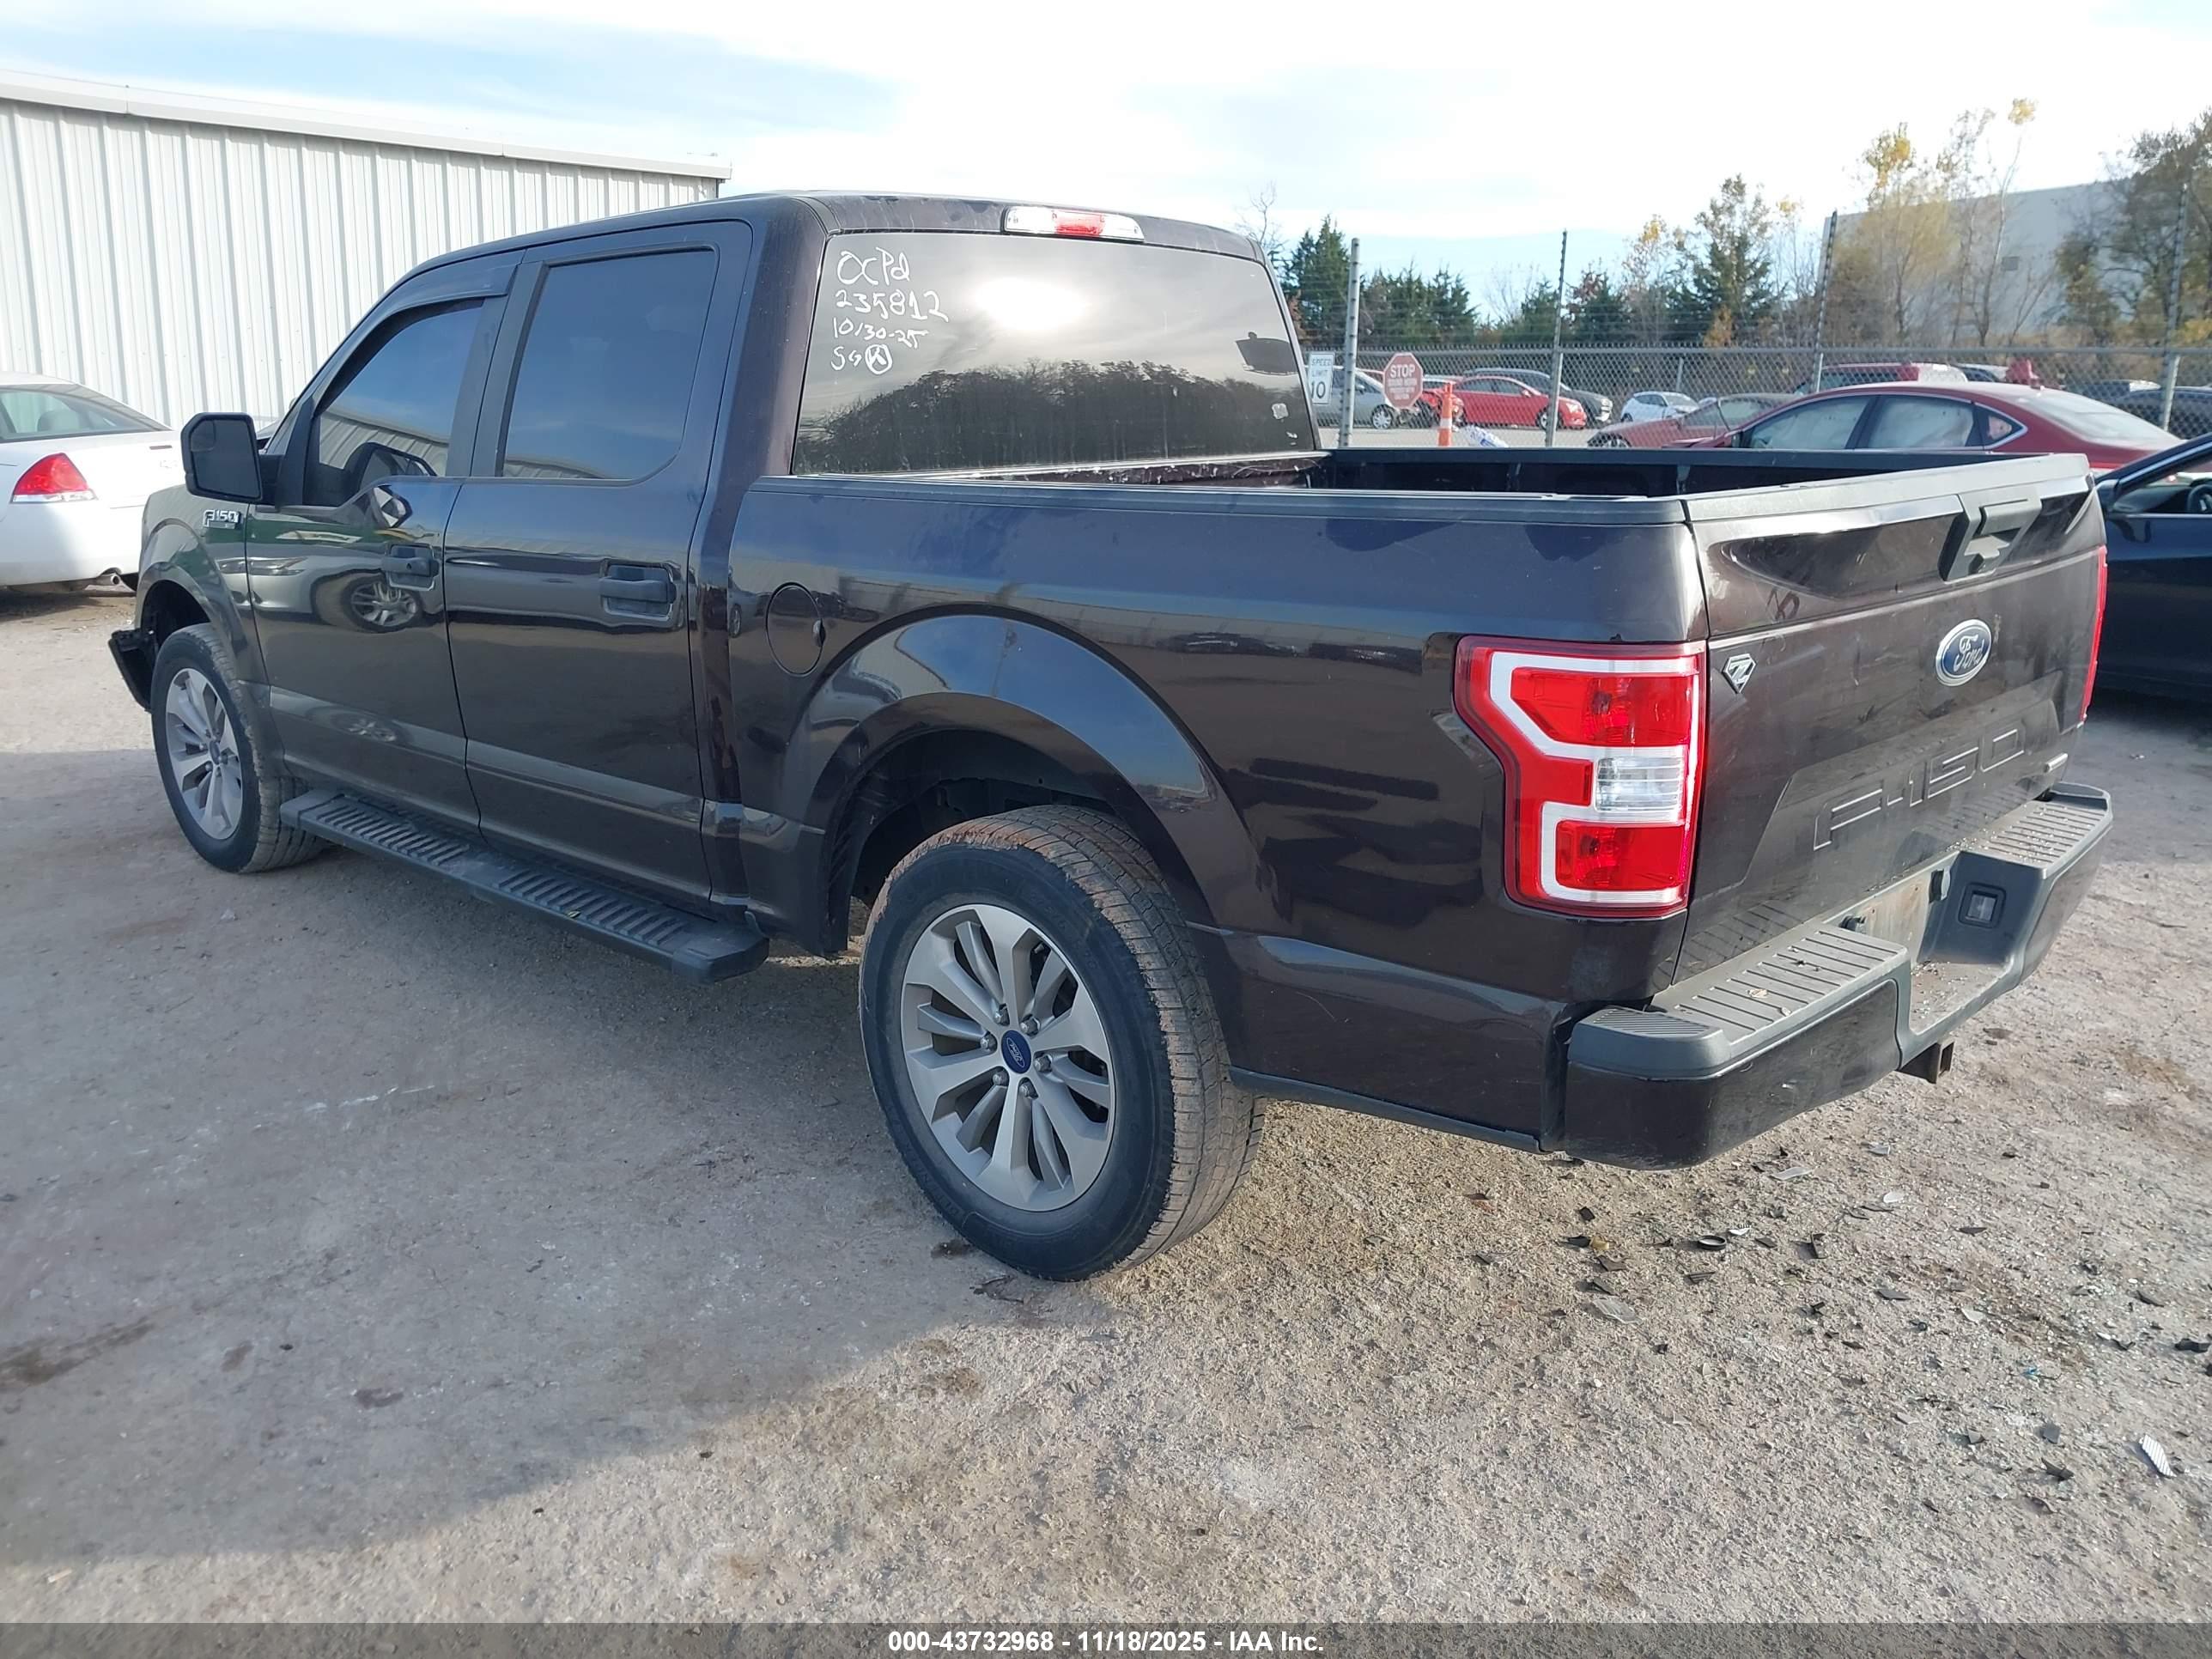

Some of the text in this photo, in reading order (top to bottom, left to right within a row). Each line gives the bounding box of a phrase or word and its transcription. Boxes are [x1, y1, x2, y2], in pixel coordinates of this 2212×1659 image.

[835, 289, 950, 323] 235812
[1390, 363, 1416, 379] STOP
[1310, 381, 1326, 399] 10
[1953, 634, 1985, 672] Ford
[1812, 721, 2027, 852] F-150
